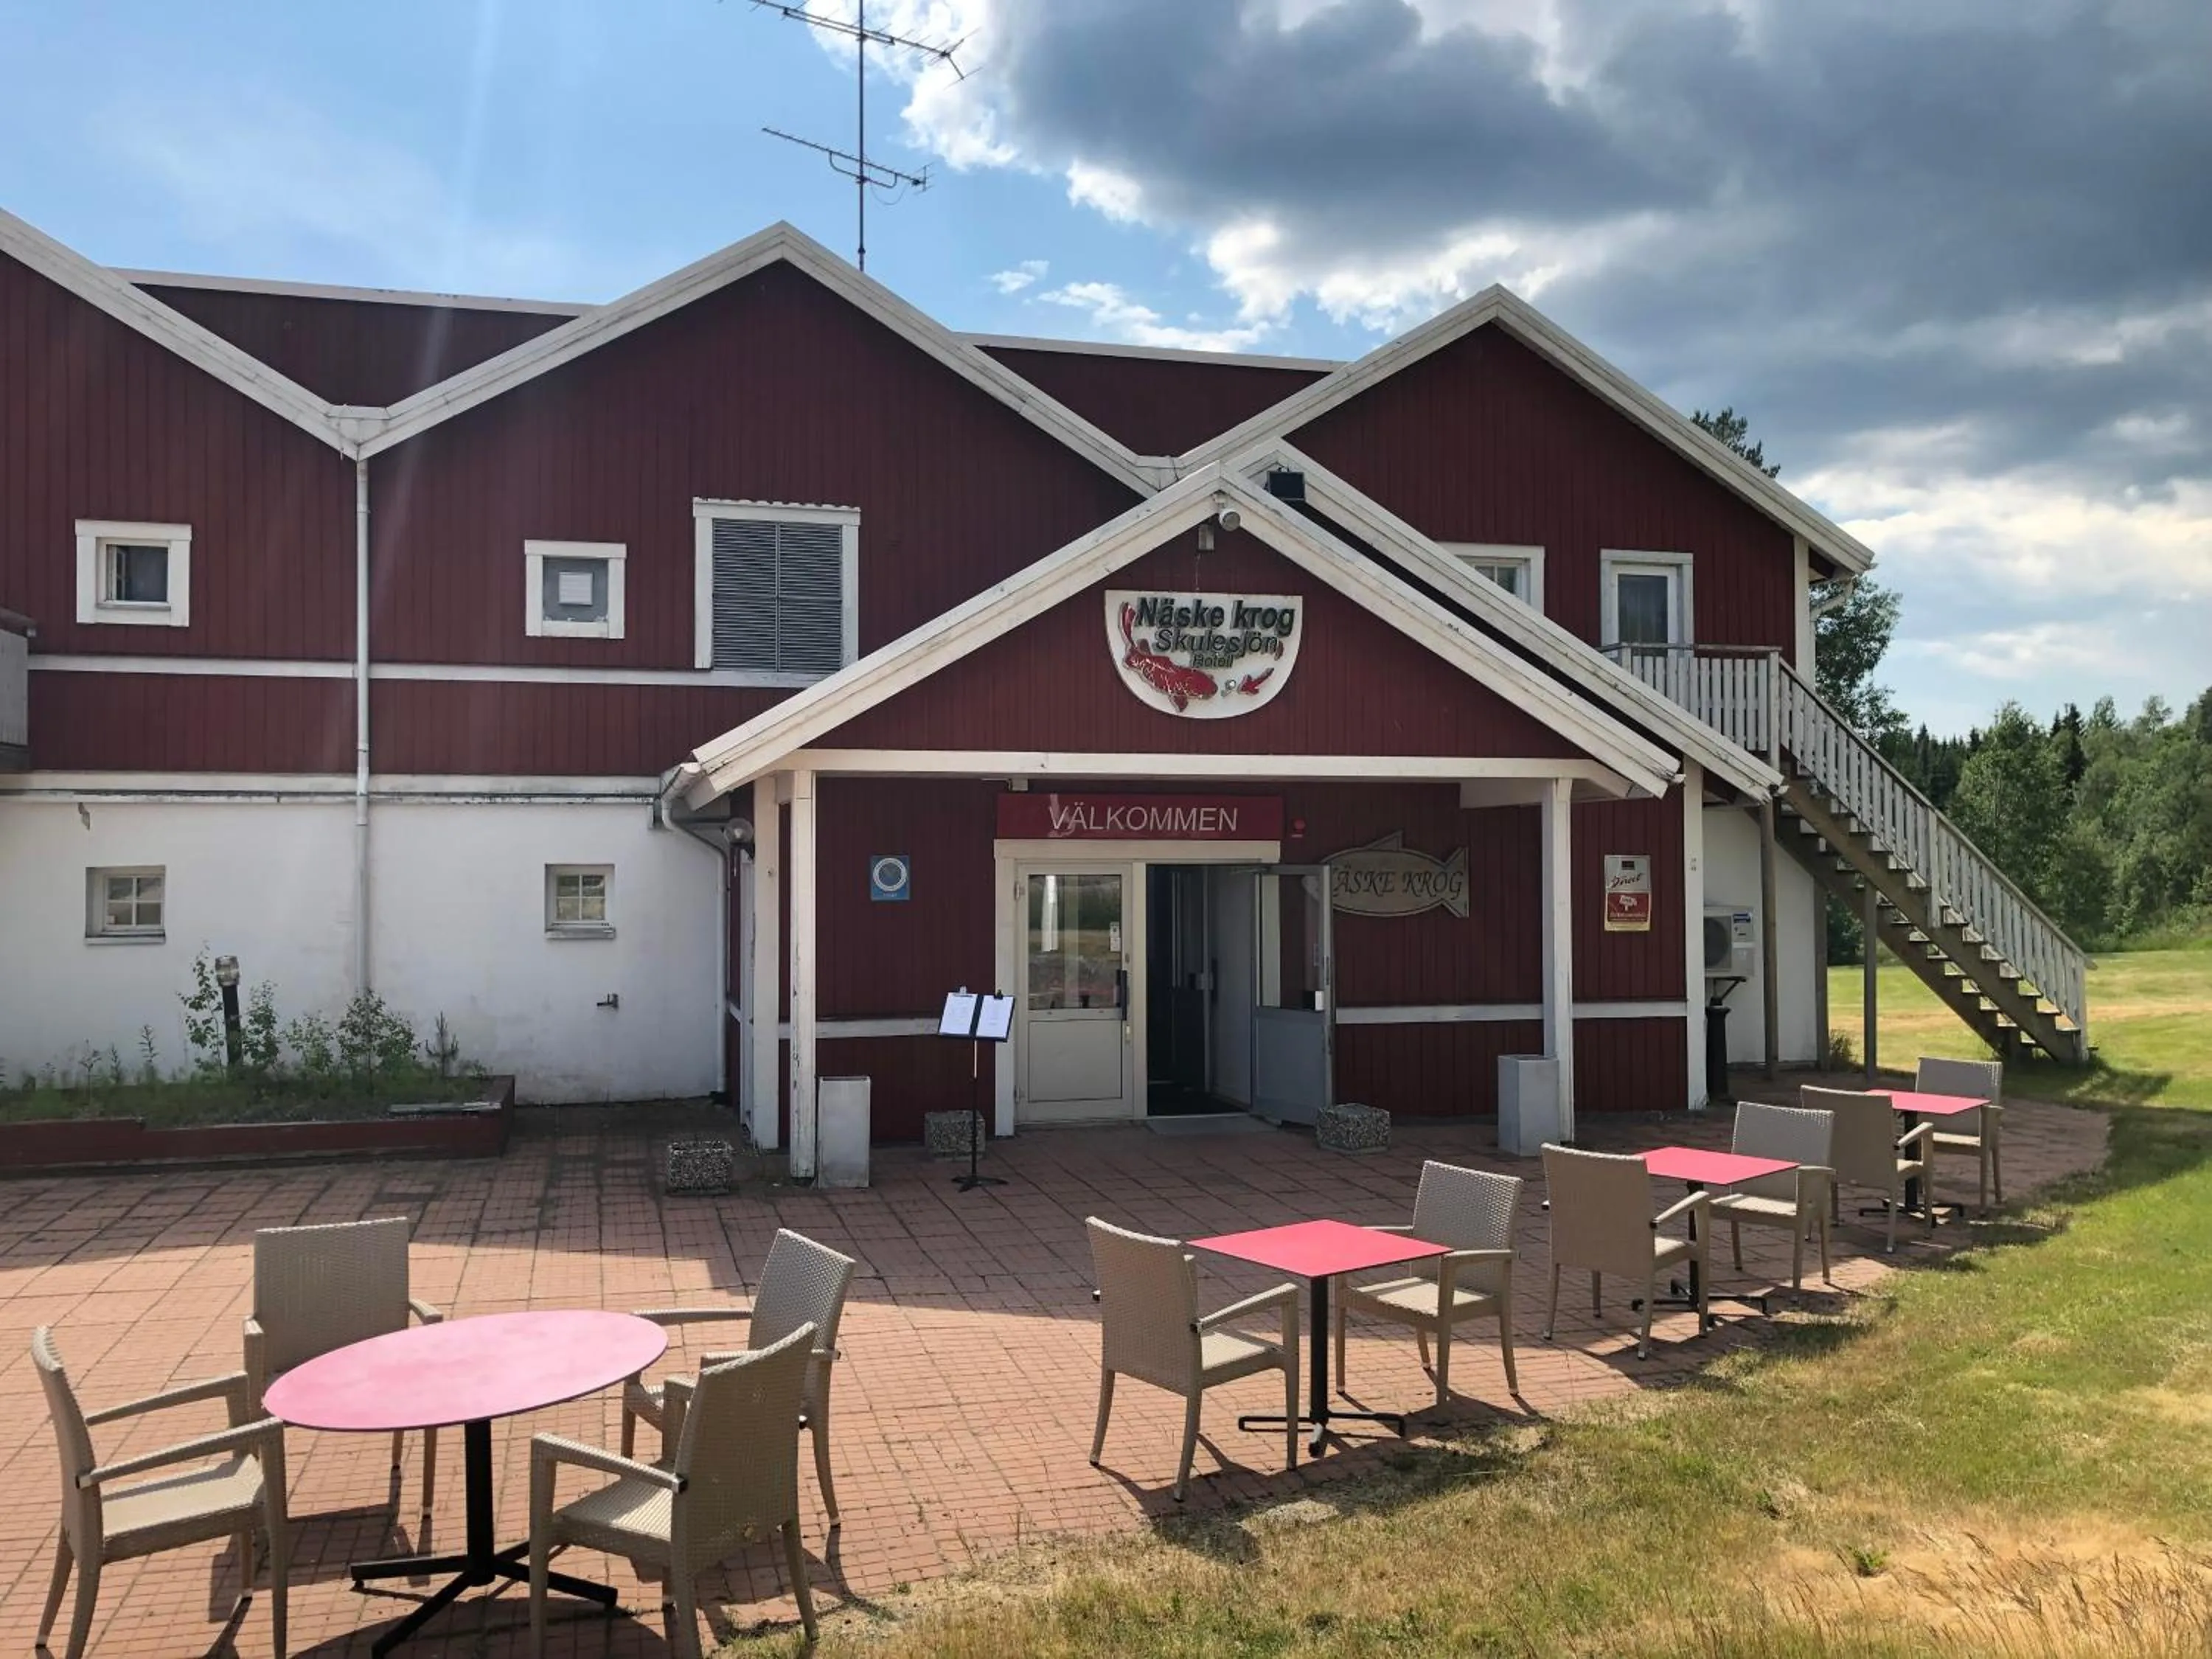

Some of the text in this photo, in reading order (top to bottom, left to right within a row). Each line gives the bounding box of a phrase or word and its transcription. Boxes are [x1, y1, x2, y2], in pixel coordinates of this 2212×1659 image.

[1137, 597, 1295, 636] Näske krog
[1153, 628, 1279, 658] Skulesjön
[1048, 801, 1239, 832] VÄLKOMMEN
[1332, 863, 1464, 900] ÄSKE KROG
